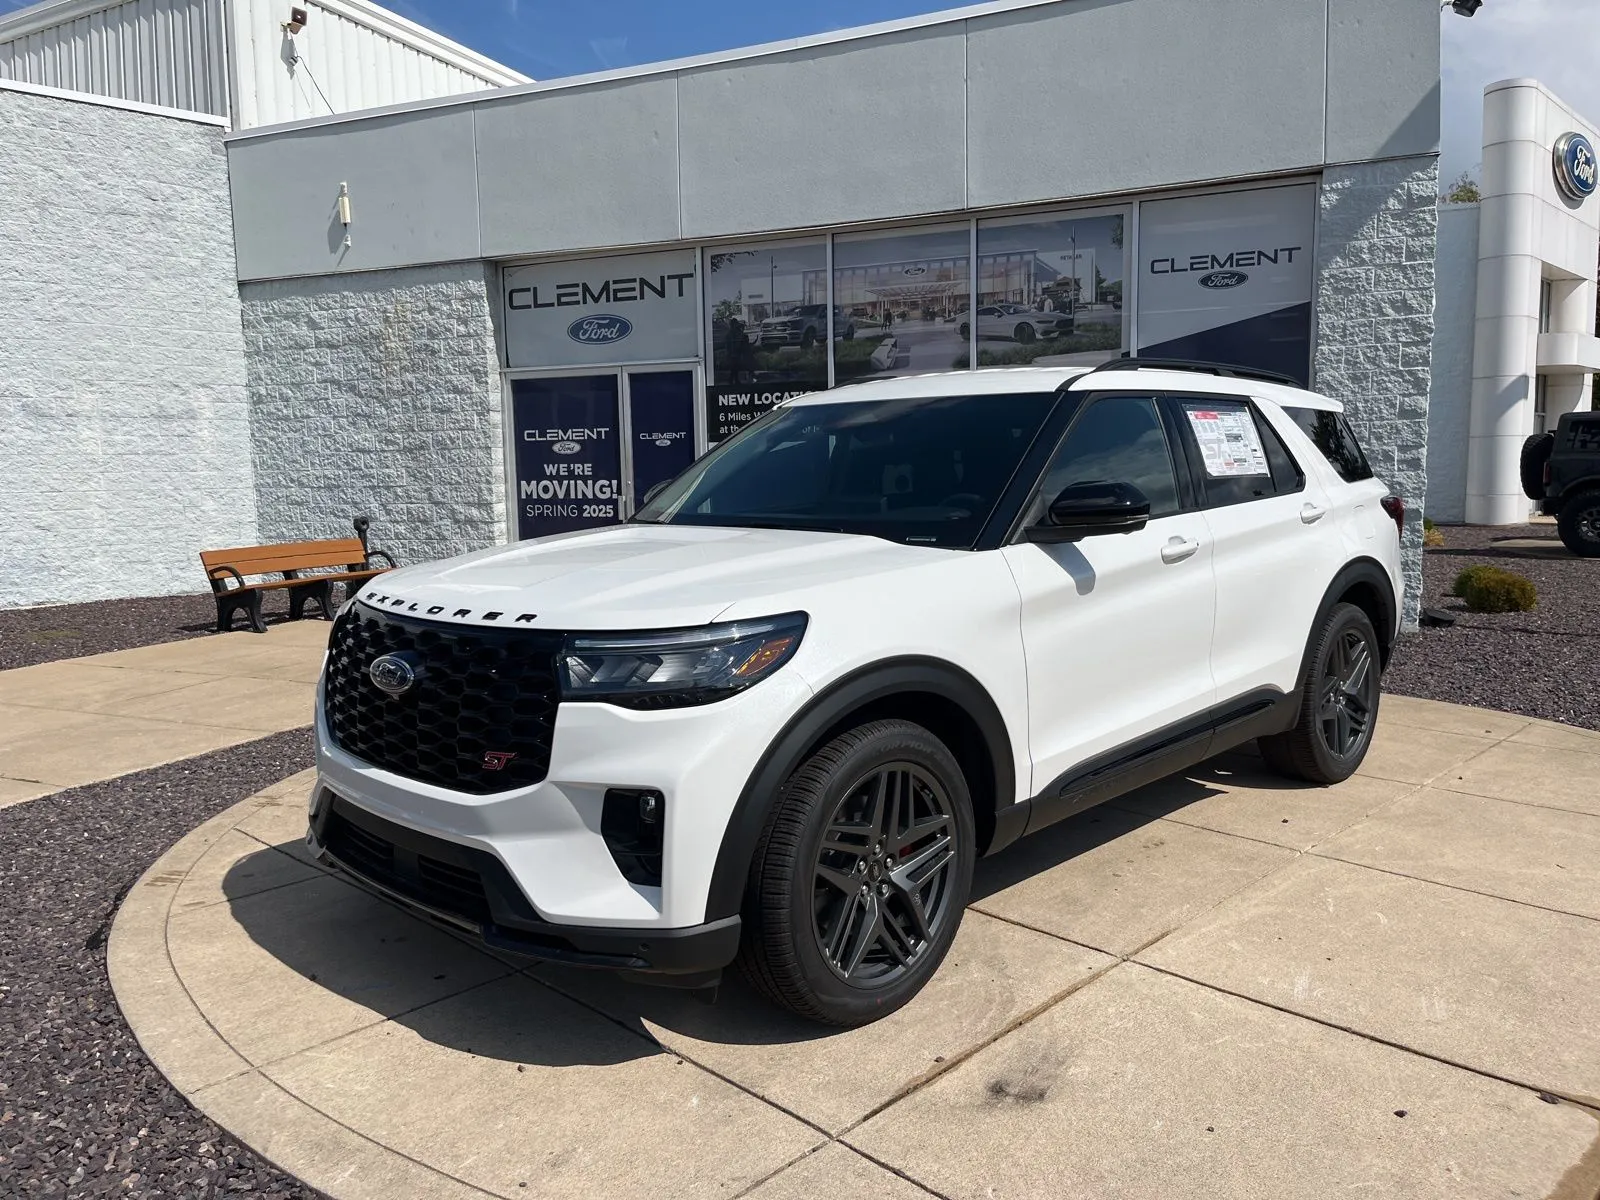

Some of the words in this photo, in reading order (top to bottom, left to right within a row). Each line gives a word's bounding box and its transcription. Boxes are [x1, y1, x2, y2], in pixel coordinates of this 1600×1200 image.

[1574, 145, 1595, 184] Ford
[1150, 246, 1302, 275] CLEMENT
[1207, 272, 1239, 287] Ford
[508, 272, 694, 310] CLEMENT
[579, 318, 620, 340] Ford
[718, 393, 751, 406] NEW
[719, 412, 726, 422] 6
[728, 411, 752, 421] Miles
[524, 427, 610, 441] CLEMENT
[639, 431, 687, 440] CLEMENT
[719, 425, 728, 434] at
[543, 463, 593, 476] WE'RE
[520, 479, 618, 500] MOVING!
[526, 504, 578, 517] SPRING
[582, 504, 614, 518] 2025
[365, 591, 539, 624] EXPLORER
[482, 750, 518, 771] ST
